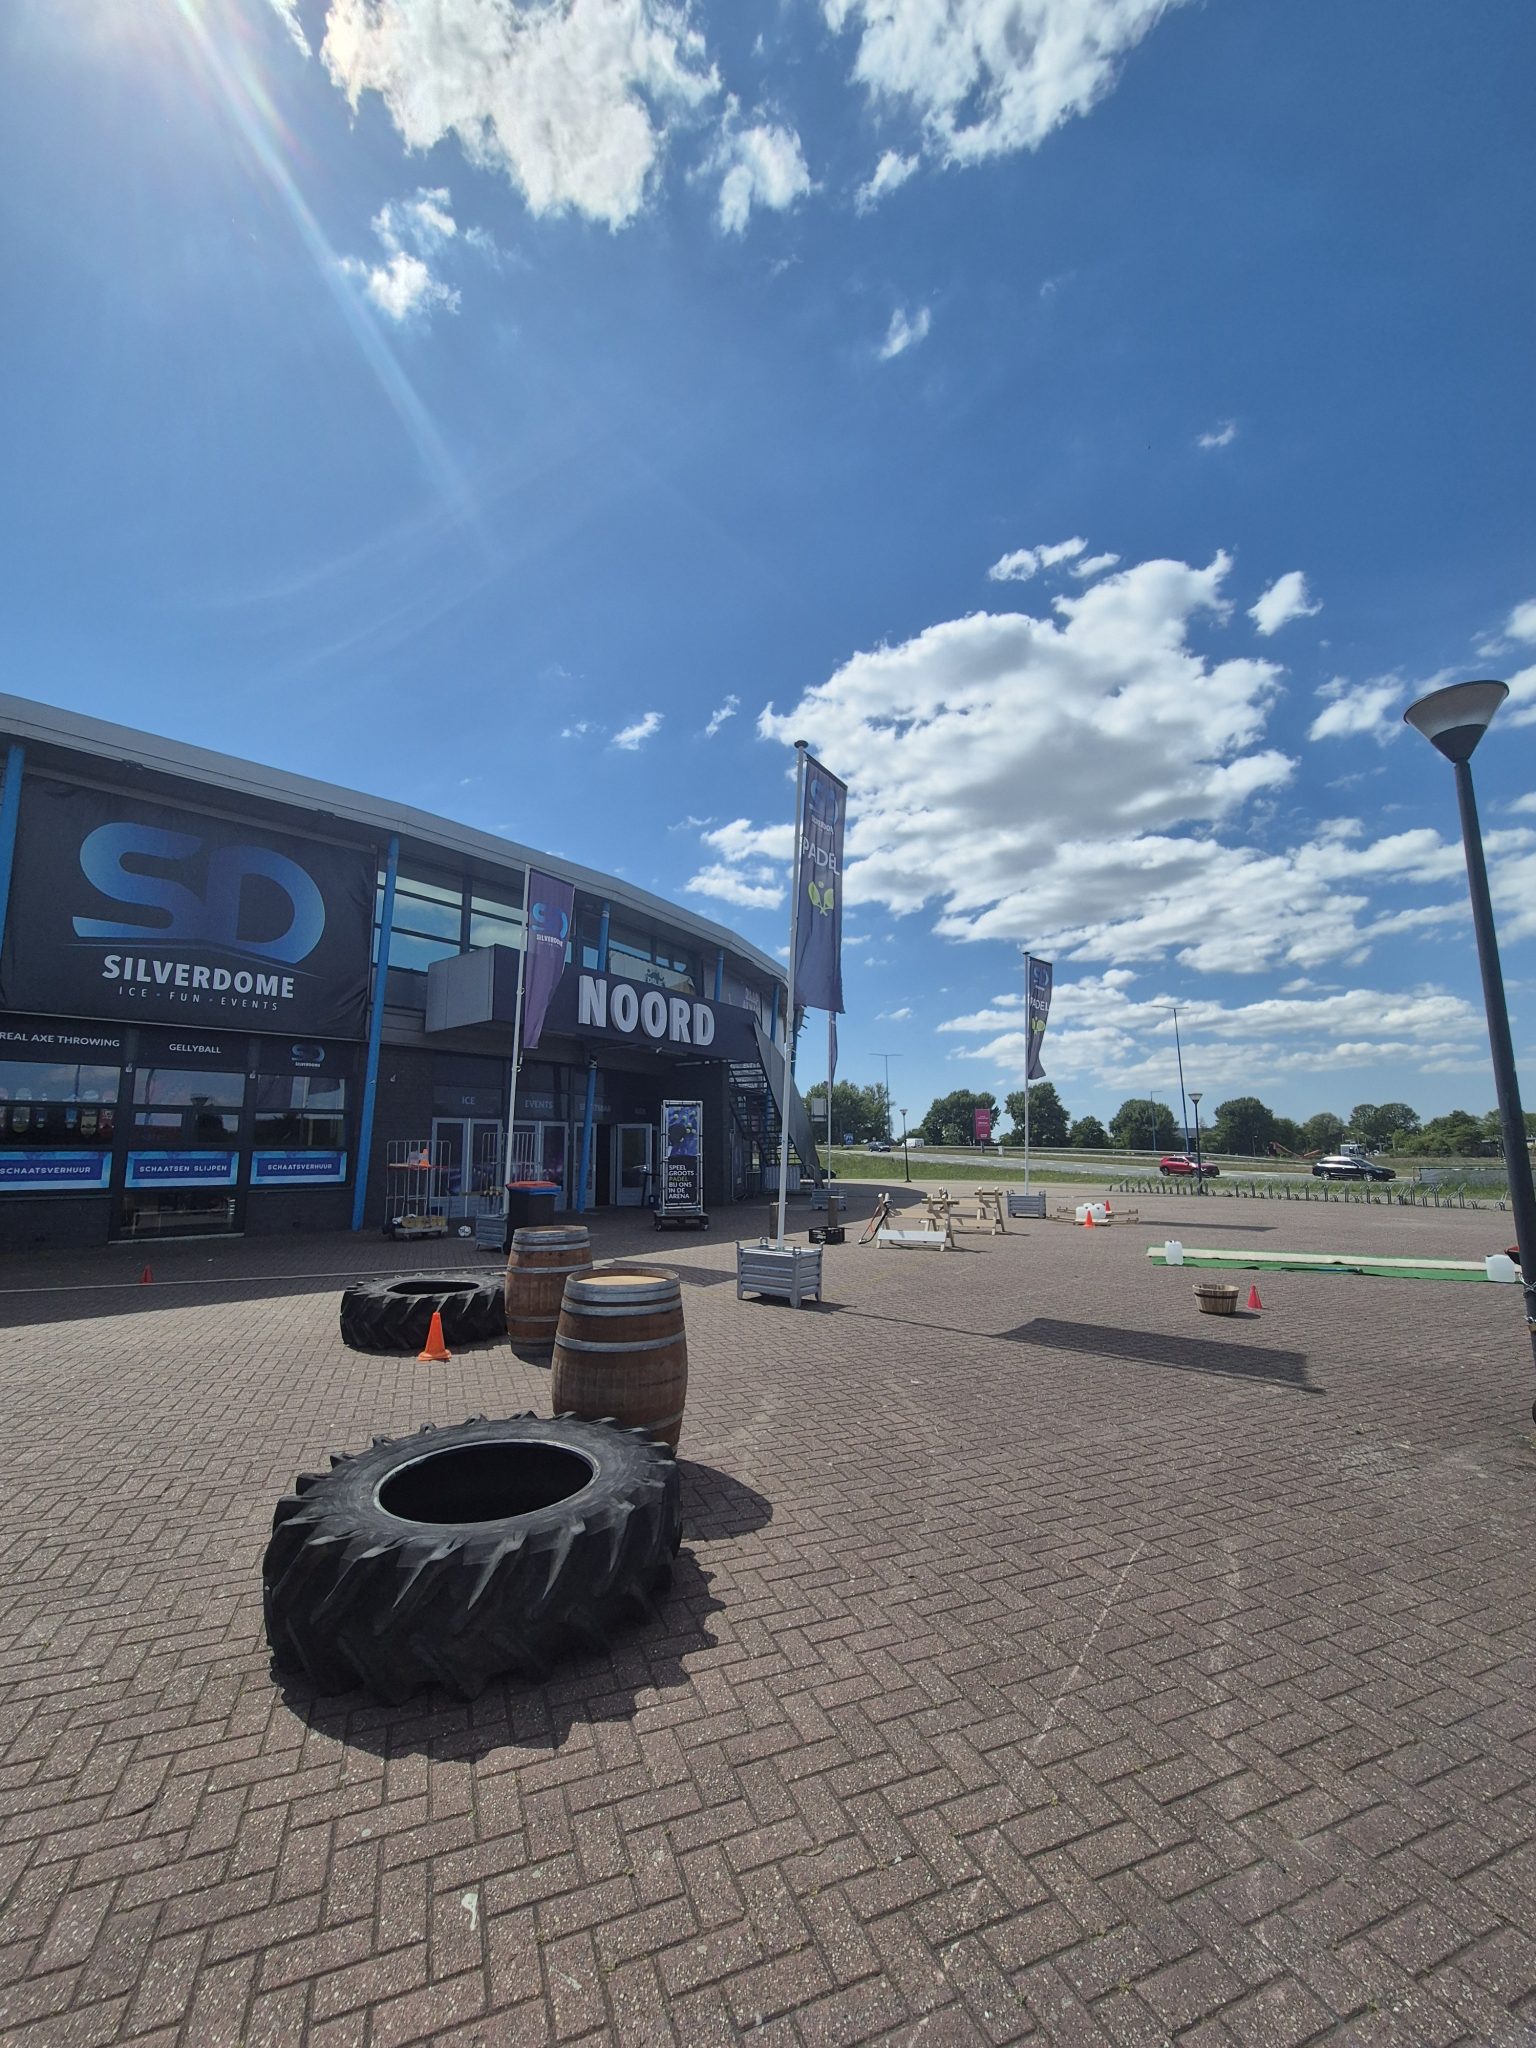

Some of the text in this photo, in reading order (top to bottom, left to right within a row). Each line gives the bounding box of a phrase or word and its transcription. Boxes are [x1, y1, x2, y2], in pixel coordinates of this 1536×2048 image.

[803, 836, 840, 876] PADEL
[72, 822, 326, 964] SD
[102, 954, 295, 999] SILVERDOME
[119, 986, 278, 1011] ICE FUN EVENTS
[578, 975, 715, 1046] NOORD
[0, 1031, 120, 1047] REAL AXE THROWING
[169, 1043, 222, 1054] GELLYBALL
[462, 1096, 475, 1105] ICE
[524, 1100, 553, 1109] EVENTS
[0, 1166, 91, 1175] SCHAATSVERHUUR
[139, 1164, 227, 1173] SCHAATSEN SLIJPEN
[267, 1163, 332, 1171] SCHAATSVERHUUR
